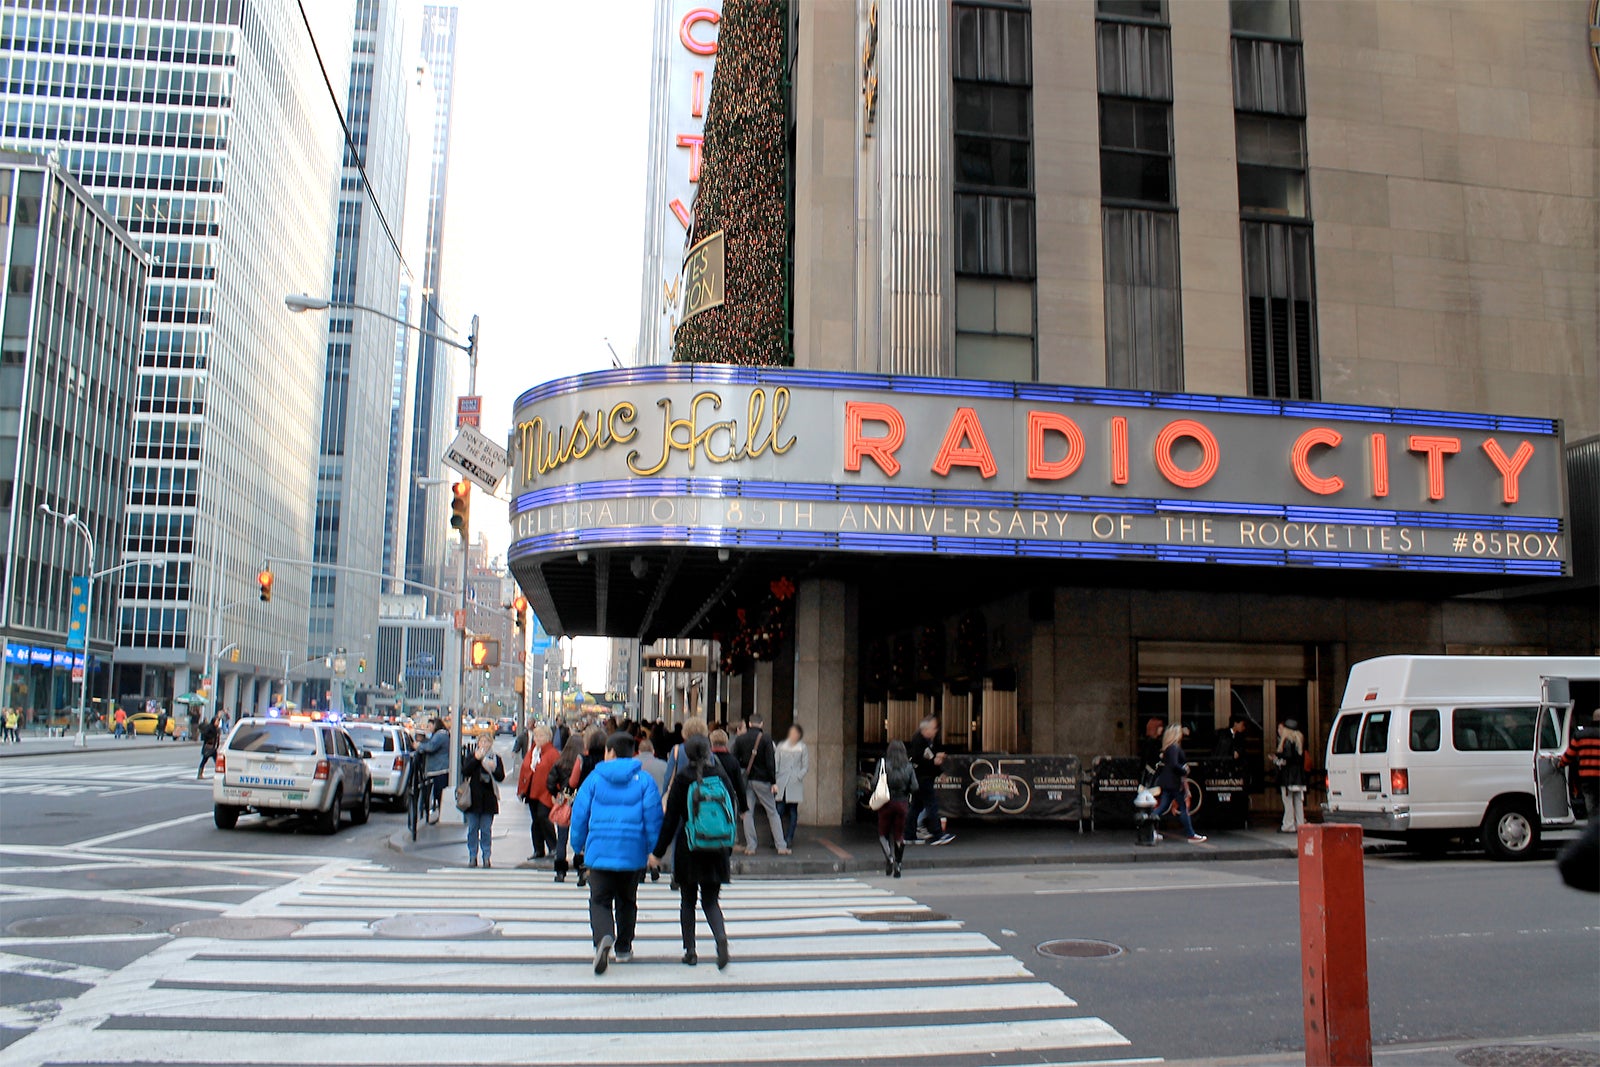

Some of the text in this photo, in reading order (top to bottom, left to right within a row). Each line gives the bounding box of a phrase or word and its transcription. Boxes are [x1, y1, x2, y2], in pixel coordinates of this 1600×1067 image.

[519, 401, 638, 487] Music
[626, 386, 798, 476] Hall
[844, 401, 1535, 504] RADIO CITY
[518, 498, 697, 538] CELEBRATION
[839, 503, 1069, 537] ANNIVERSARY
[1091, 514, 1132, 540] OF
[1159, 517, 1216, 545] THE
[1452, 531, 1559, 558] #85ROX
[655, 657, 685, 669] Subway
[239, 776, 295, 786] NYPD TRAFFIC
